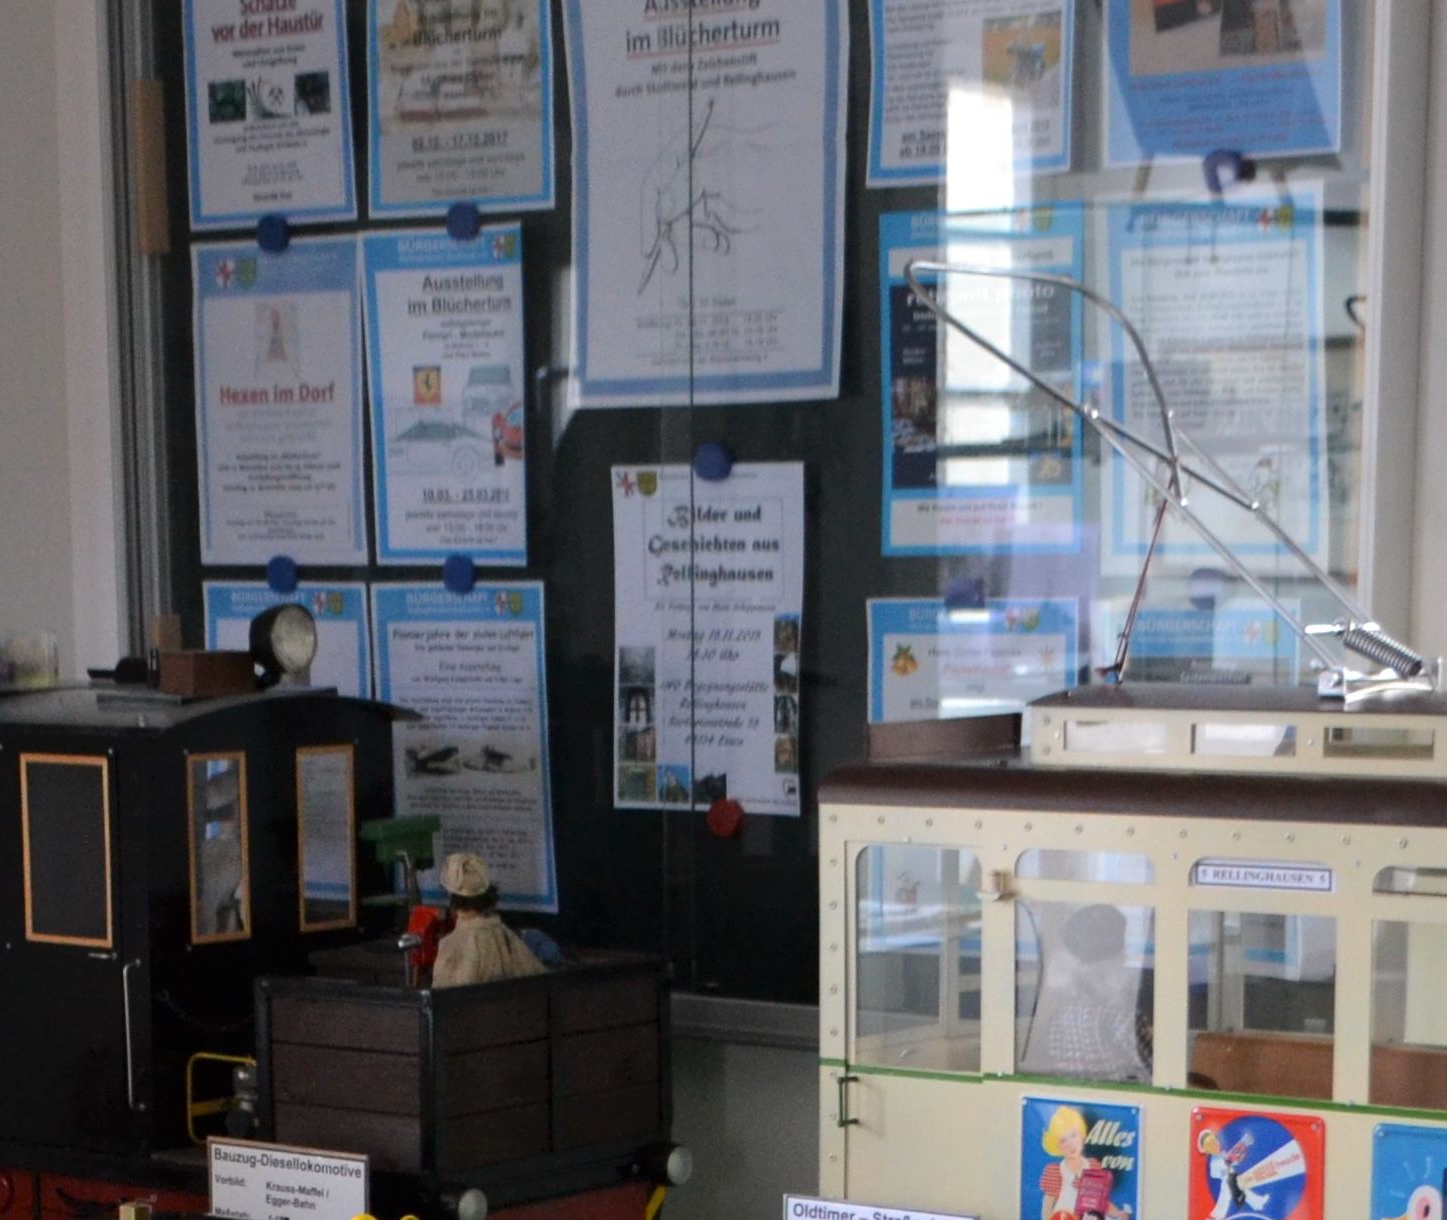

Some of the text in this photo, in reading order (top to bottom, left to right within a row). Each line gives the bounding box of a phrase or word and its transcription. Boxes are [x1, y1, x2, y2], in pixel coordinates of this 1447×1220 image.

[212, 11, 323, 42] vor der Haustür
[626, 29, 650, 51] im
[408, 300, 427, 315] im
[220, 382, 335, 405] Hexen im Dorf
[667, 505, 761, 529] Blder und
[752, 537, 779, 551] aus
[1212, 869, 1314, 883] RELLINGHAUSEN
[1319, 875, 1325, 884] 5
[1085, 1119, 1135, 1148] Alles
[214, 1148, 362, 1179] Bauzug-Diesellokomotive
[1101, 1155, 1135, 1172] von
[214, 1174, 247, 1187] Vorbild:
